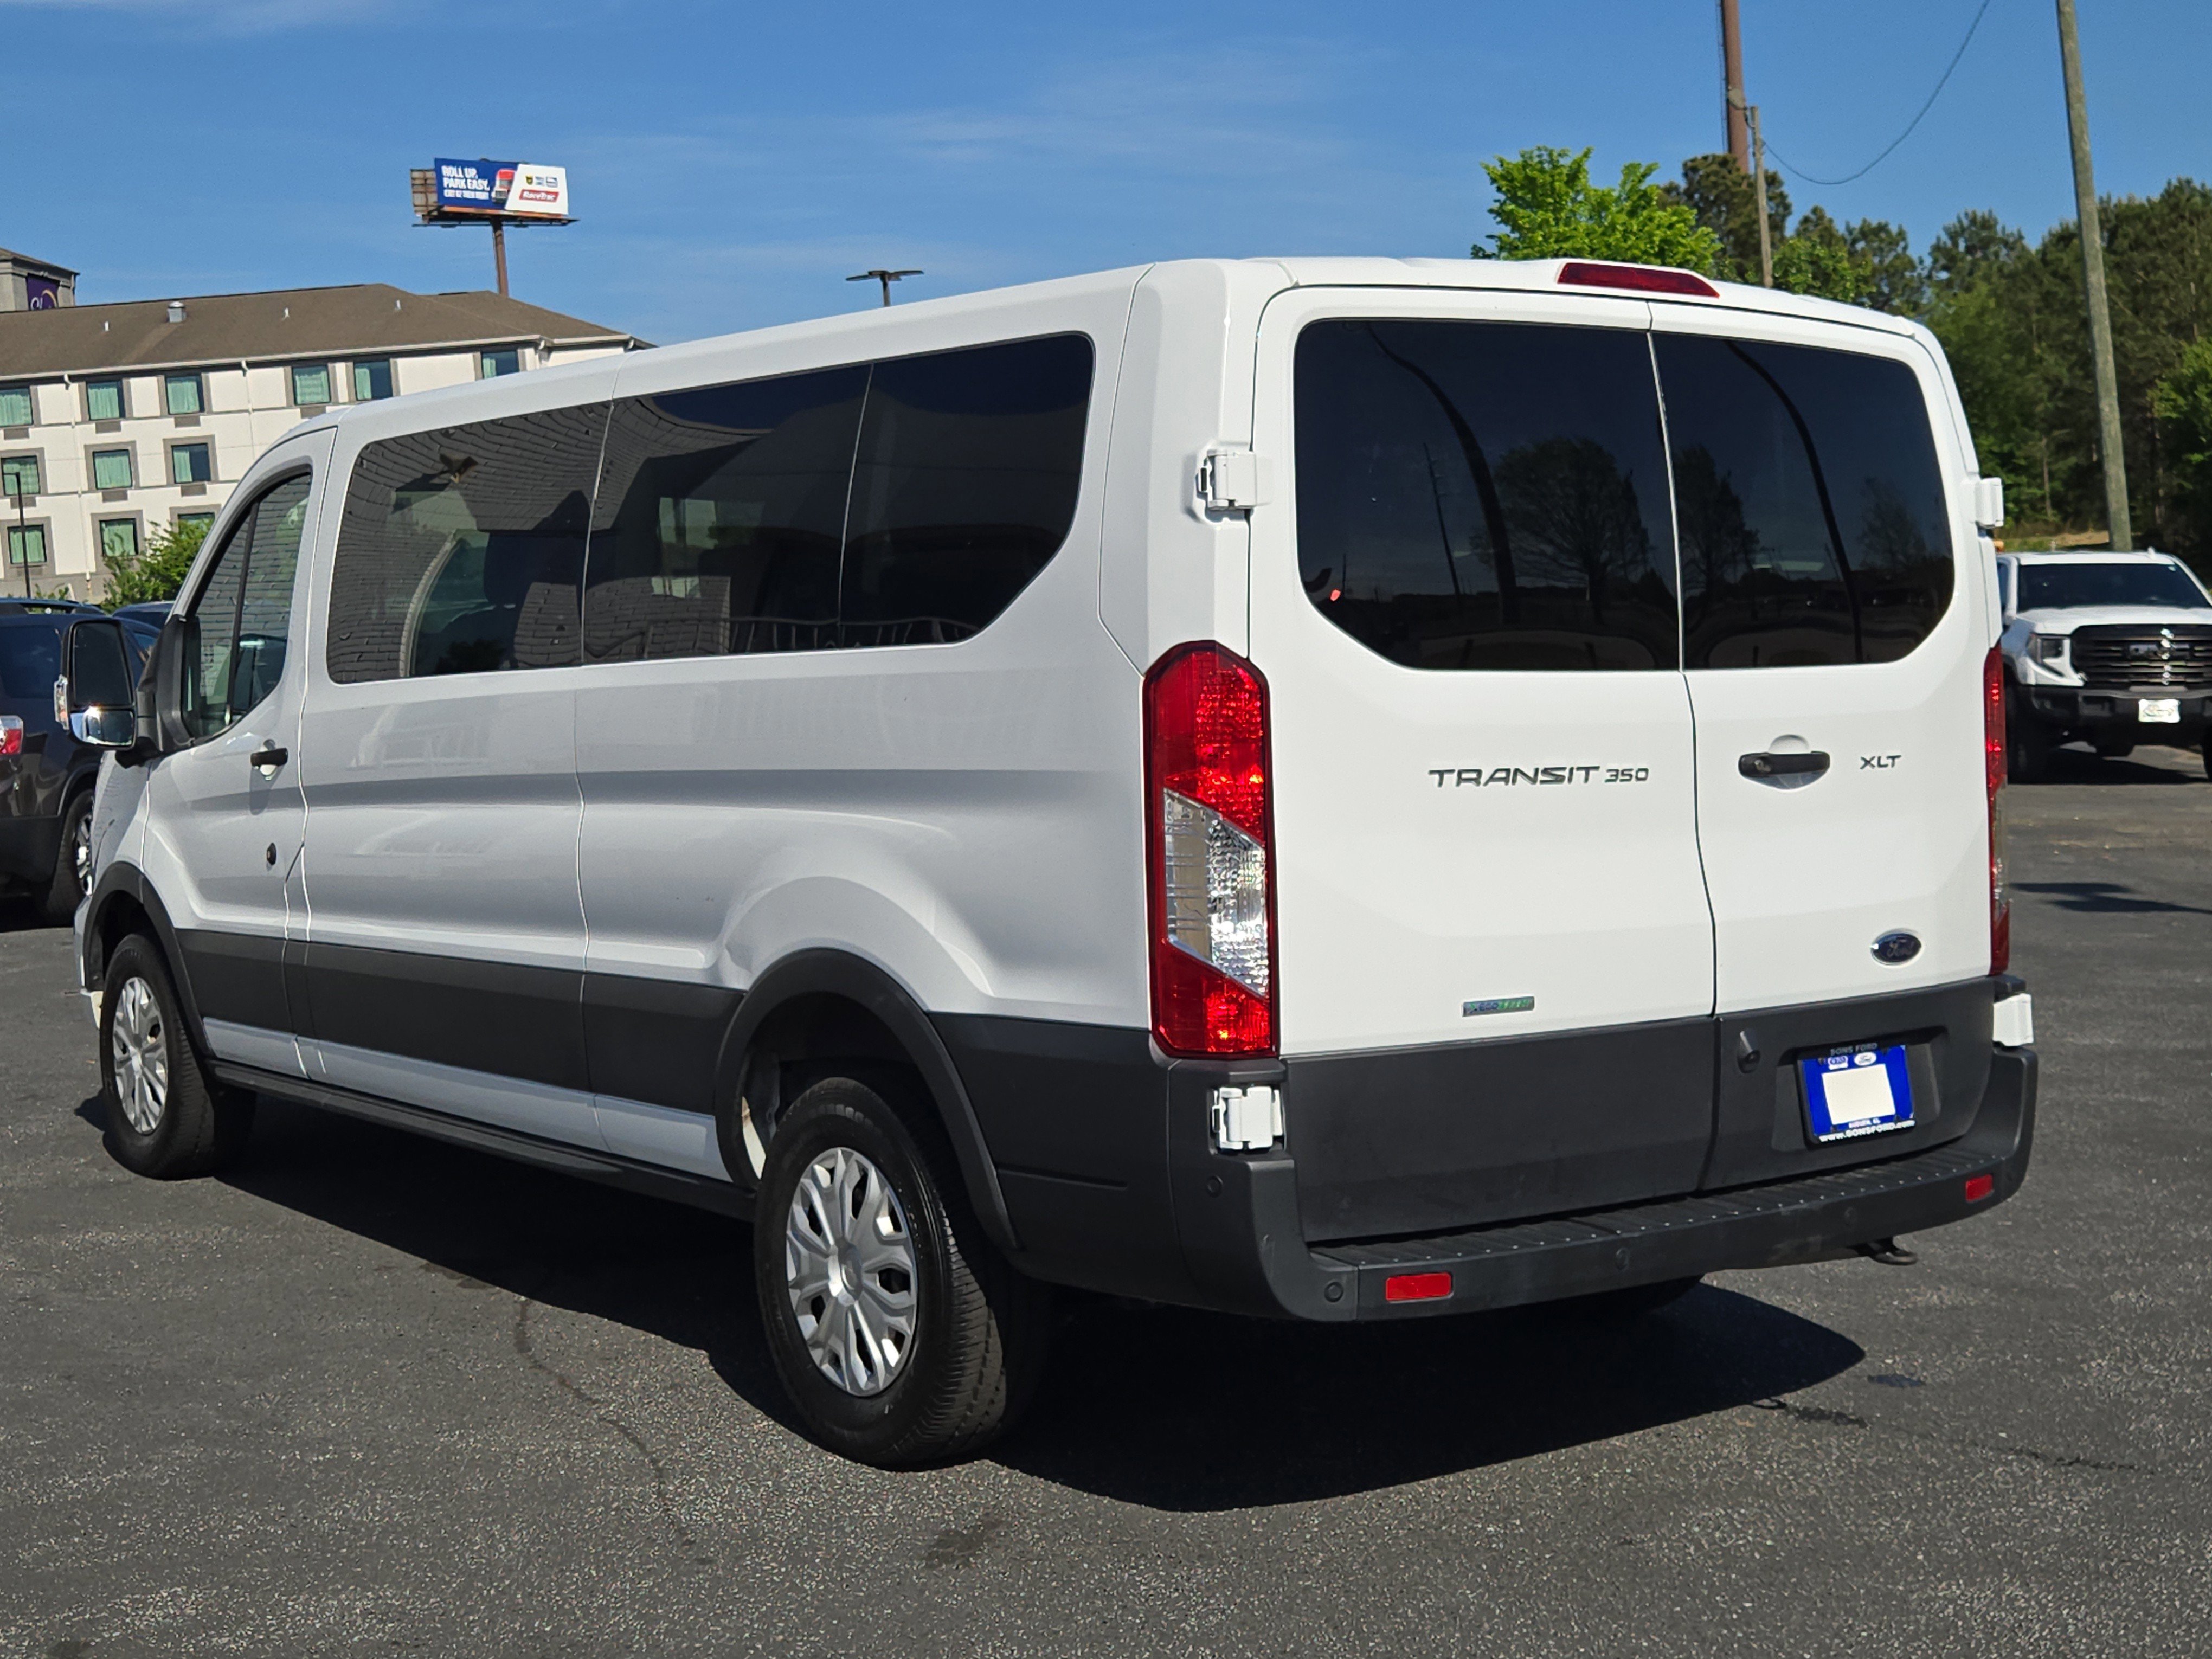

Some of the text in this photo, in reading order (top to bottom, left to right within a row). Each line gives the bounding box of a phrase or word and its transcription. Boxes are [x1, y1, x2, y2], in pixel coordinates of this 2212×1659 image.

[441, 165, 464, 178] ROLL
[443, 177, 466, 189] PARK
[1860, 755, 1902, 769] XLT
[1429, 766, 1649, 788] TRANSIT 350
[1855, 1043, 1878, 1052] FORD
